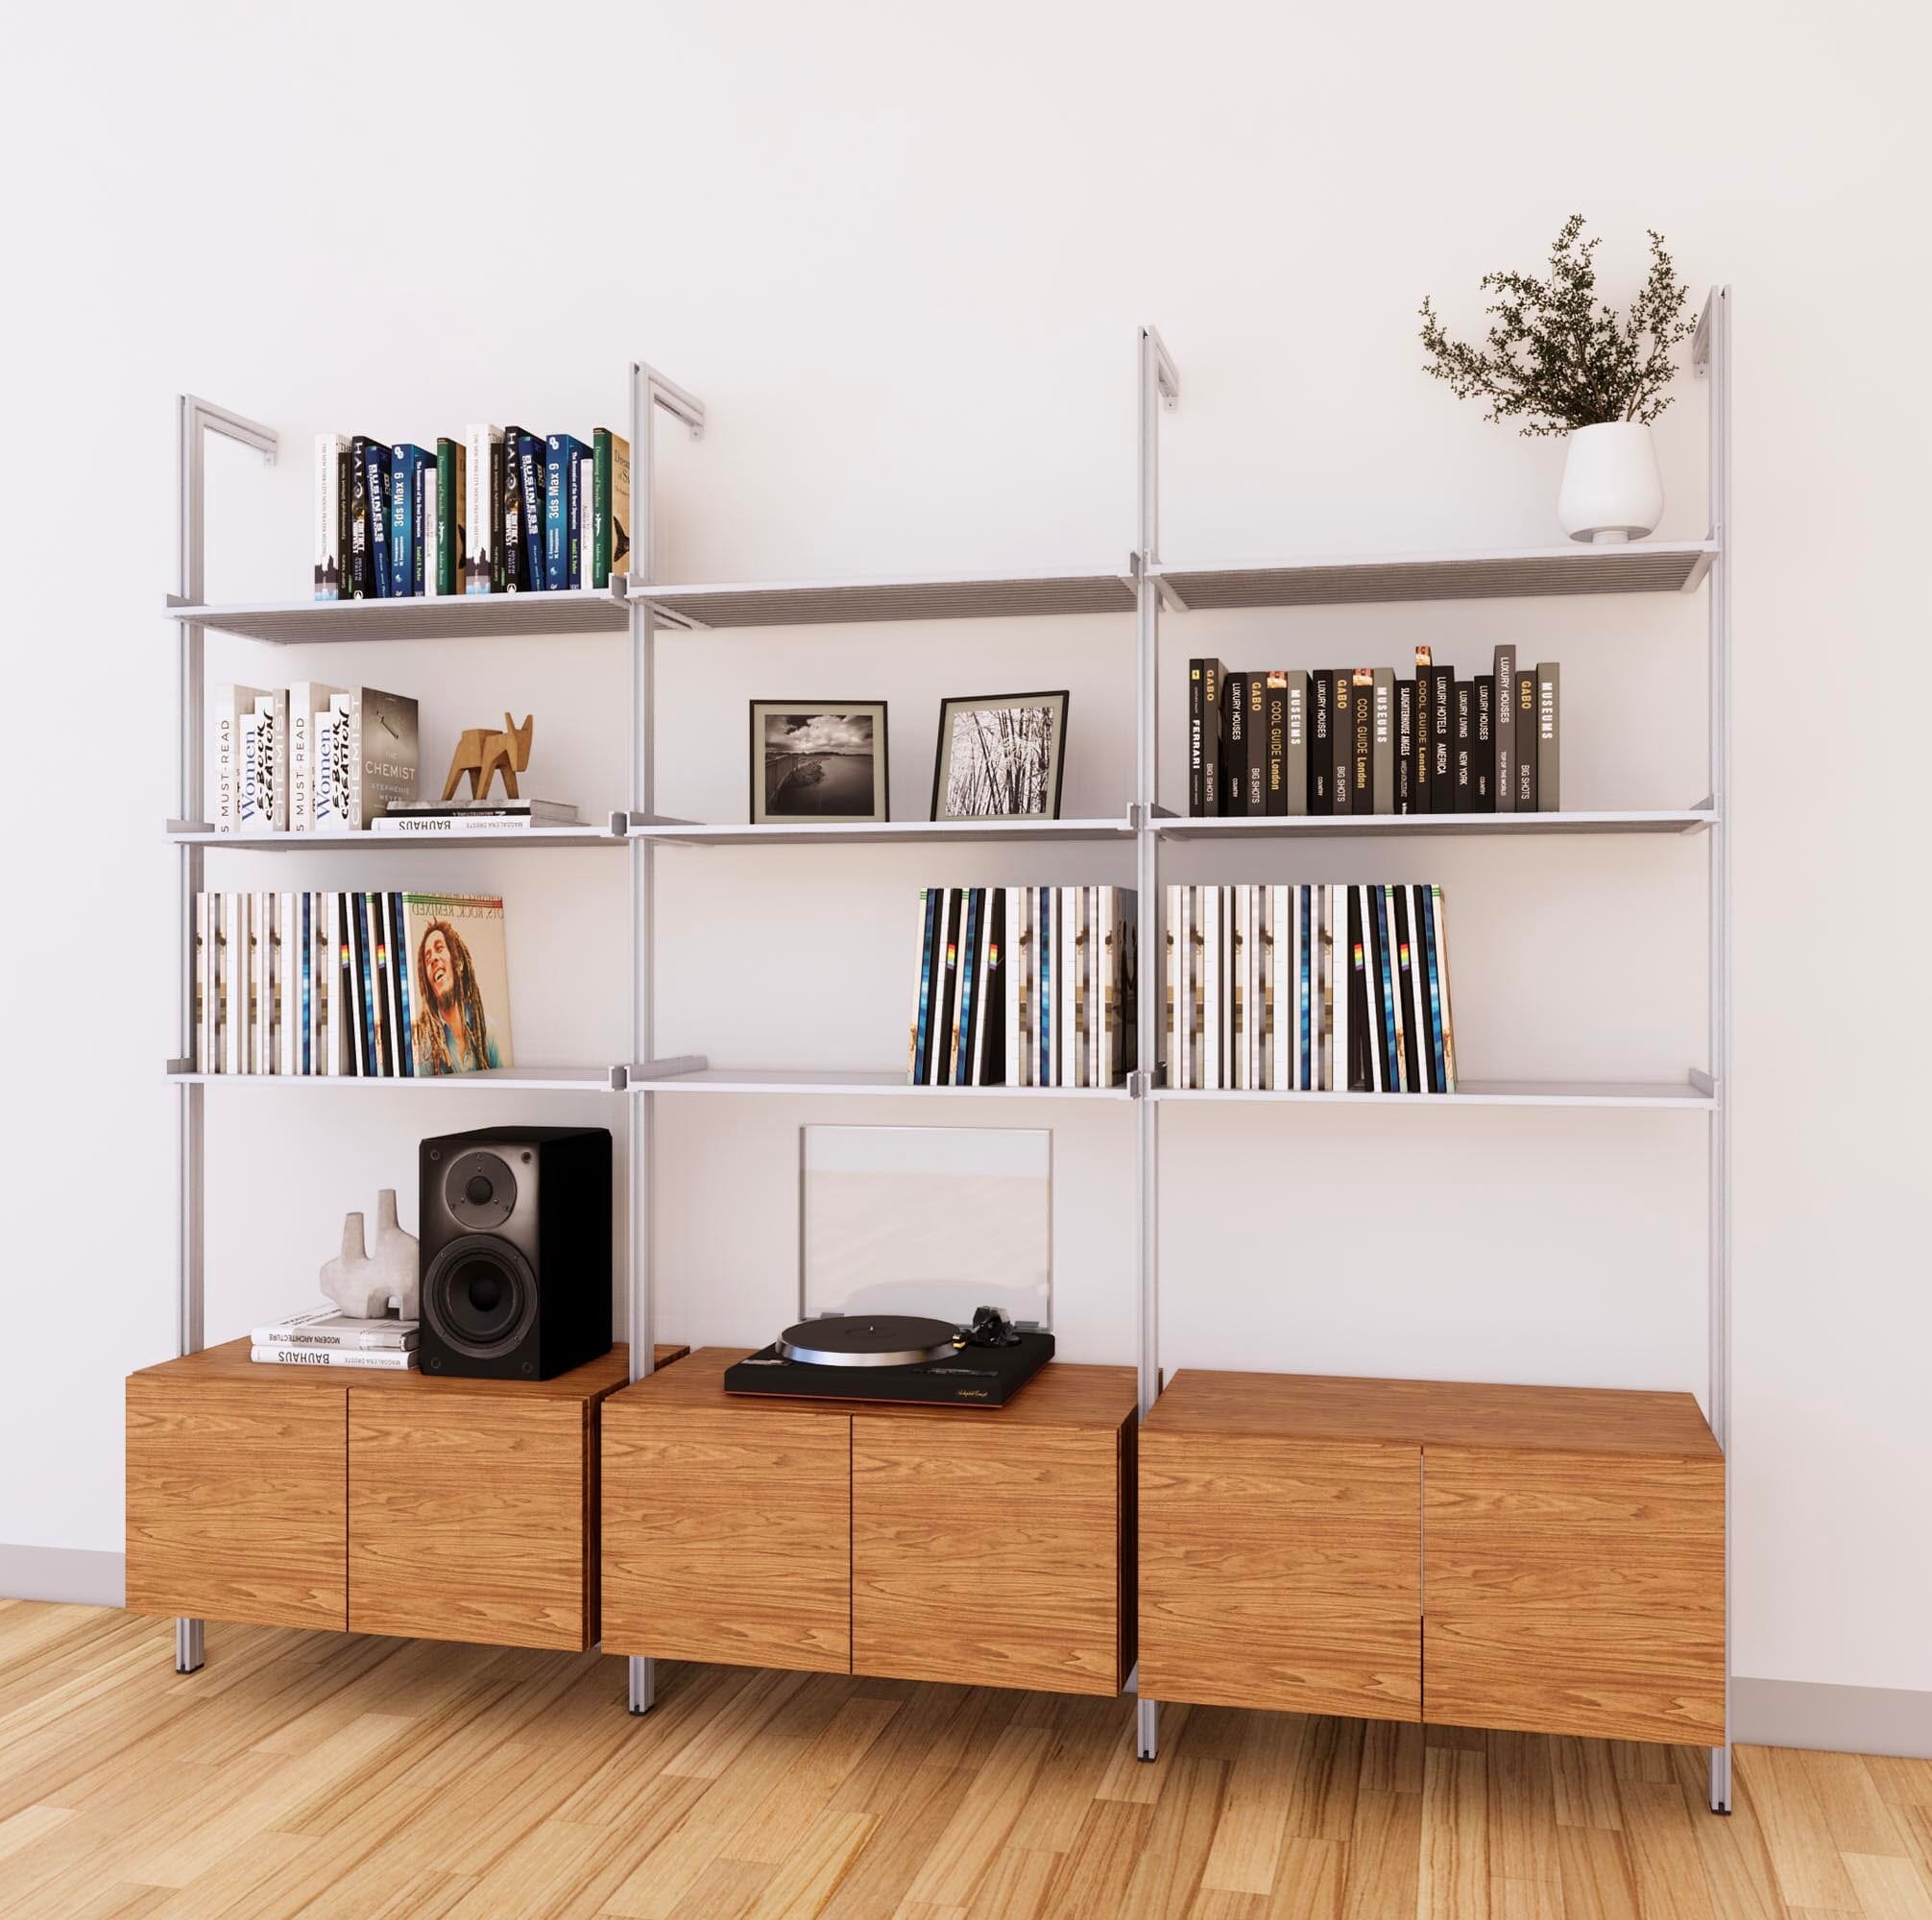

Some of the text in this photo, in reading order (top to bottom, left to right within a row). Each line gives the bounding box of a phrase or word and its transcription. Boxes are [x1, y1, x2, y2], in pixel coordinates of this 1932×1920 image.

[353, 442, 363, 497] HALO
[507, 432, 517, 489] HALO
[549, 463, 559, 471] 9
[549, 474, 559, 497] Max
[373, 463, 384, 542] BUSINESS
[394, 484, 403, 506] Max
[394, 509, 403, 528] 3ds
[526, 454, 538, 534] BUSINESS
[549, 500, 559, 520] 3ds
[1252, 682, 1262, 710] GABO
[1291, 689, 1300, 745] MUSEUMS
[1338, 680, 1346, 709] GABO
[1377, 686, 1387, 742] MUSEUMS
[1400, 687, 1410, 733] SLAUGHTERHOUSE
[1480, 685, 1488, 739] LUXURY HOUSES
[1500, 657, 1509, 722] LUXURY HOUSES
[1521, 681, 1532, 708] GABO
[1542, 682, 1553, 739] MUSEUMS
[1271, 701, 1281, 790] COOL GUIDE London
[1358, 697, 1367, 787] COOL GUIDE London
[1400, 735, 1410, 755] ANGELS
[1437, 677, 1446, 774] LUXURY HOTELS AMERICA
[242, 731, 255, 822] Women
[256, 722, 266, 810] E-BOOK
[263, 708, 273, 821] CREATION
[276, 699, 284, 826] CHEMIST
[296, 718, 304, 815] MUST-READ
[317, 728, 330, 821] Women
[332, 719, 341, 808] E-BOOK
[339, 707, 350, 820] CREATION
[365, 760, 415, 780] CHEMIST
[1337, 766, 1345, 803] BIG SHOTS
[1521, 764, 1530, 799] BIG SHOTS
[399, 820, 451, 829] BAUHAUS
[269, 1334, 313, 1344] ARCHITECTURE
[278, 1352, 330, 1364] BAUHAUS
